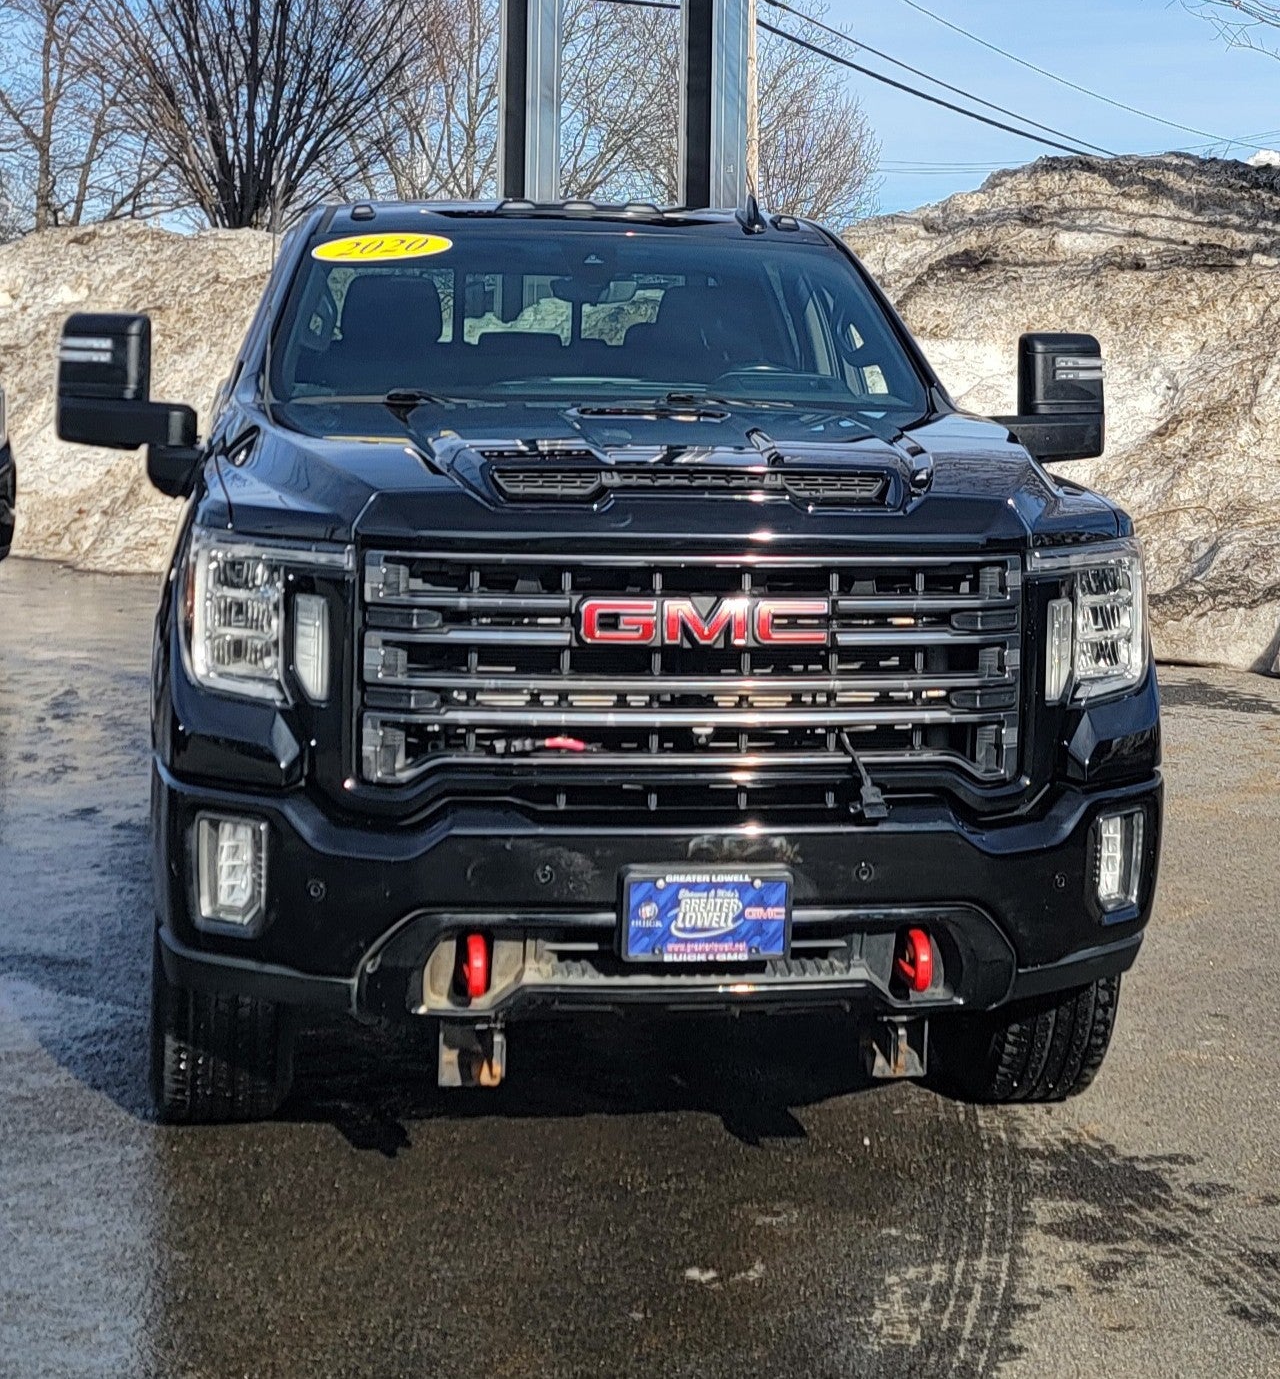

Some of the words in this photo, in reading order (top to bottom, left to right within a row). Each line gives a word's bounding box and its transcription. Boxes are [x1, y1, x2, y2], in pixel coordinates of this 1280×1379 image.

[336, 238, 430, 257] 2020
[580, 598, 829, 646] GMC
[665, 874, 710, 883] GREATER
[711, 874, 752, 882] LOWELL
[680, 898, 740, 913] GREATER
[677, 912, 736, 928] LOWELL
[744, 907, 786, 920] GMC
[663, 952, 707, 962] BUICK
[715, 952, 749, 962] GMC
